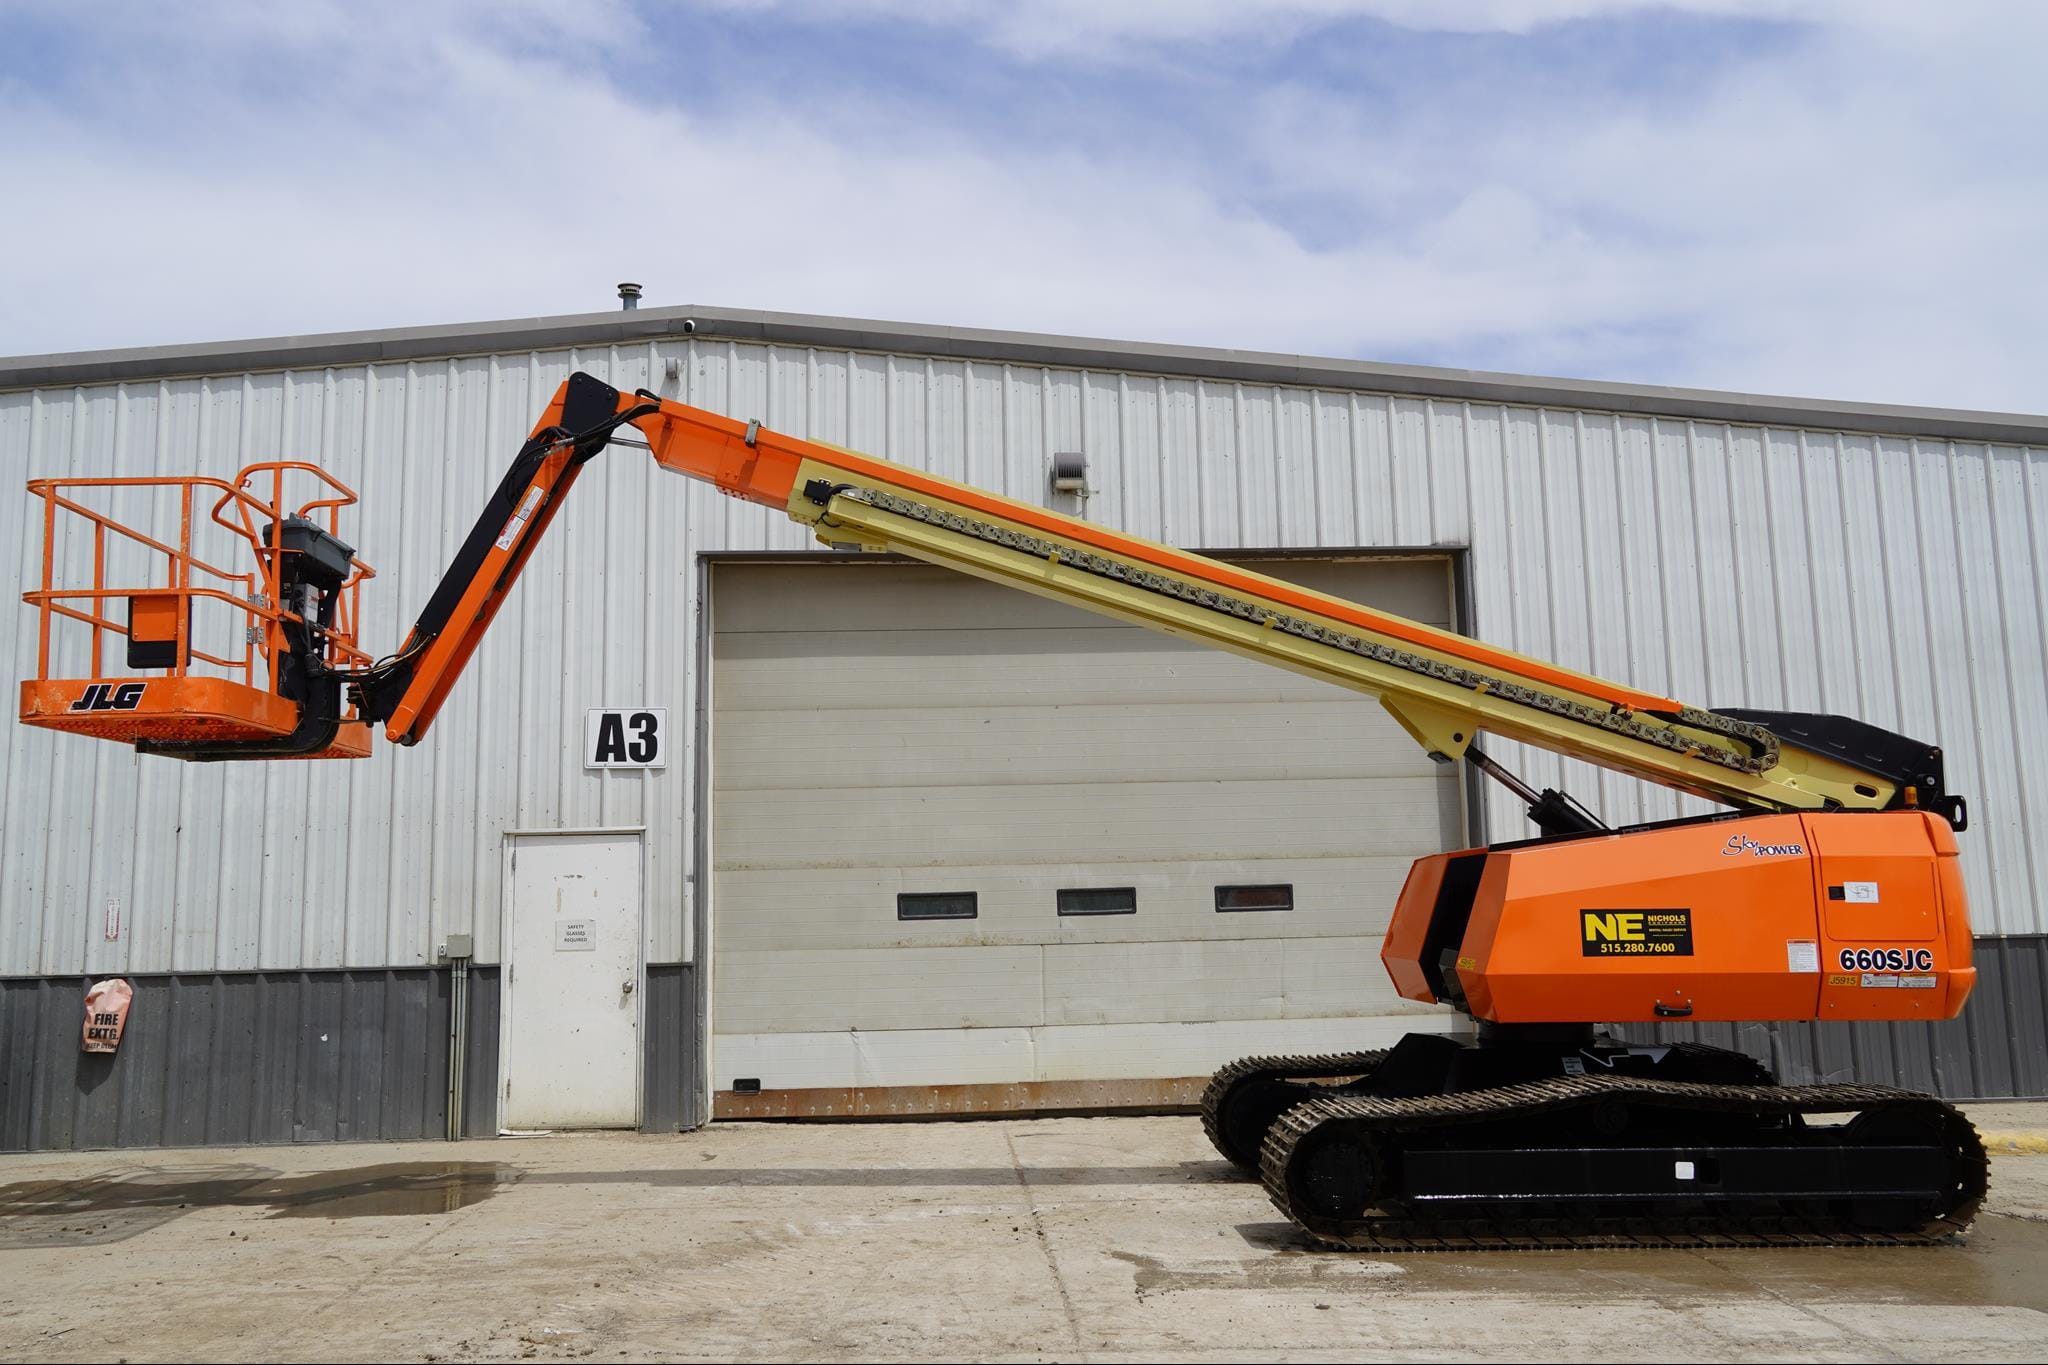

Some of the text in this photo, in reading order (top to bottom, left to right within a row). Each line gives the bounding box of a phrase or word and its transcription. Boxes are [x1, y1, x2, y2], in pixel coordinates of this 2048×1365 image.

[69, 683, 147, 711] JLG
[595, 713, 658, 763] A3
[1585, 914, 1646, 941] NE
[1601, 943, 1675, 953] 515.280.7600
[1839, 948, 1933, 971] 660SJC
[1830, 976, 1856, 985] J5915
[94, 1013, 119, 1025] FIRE
